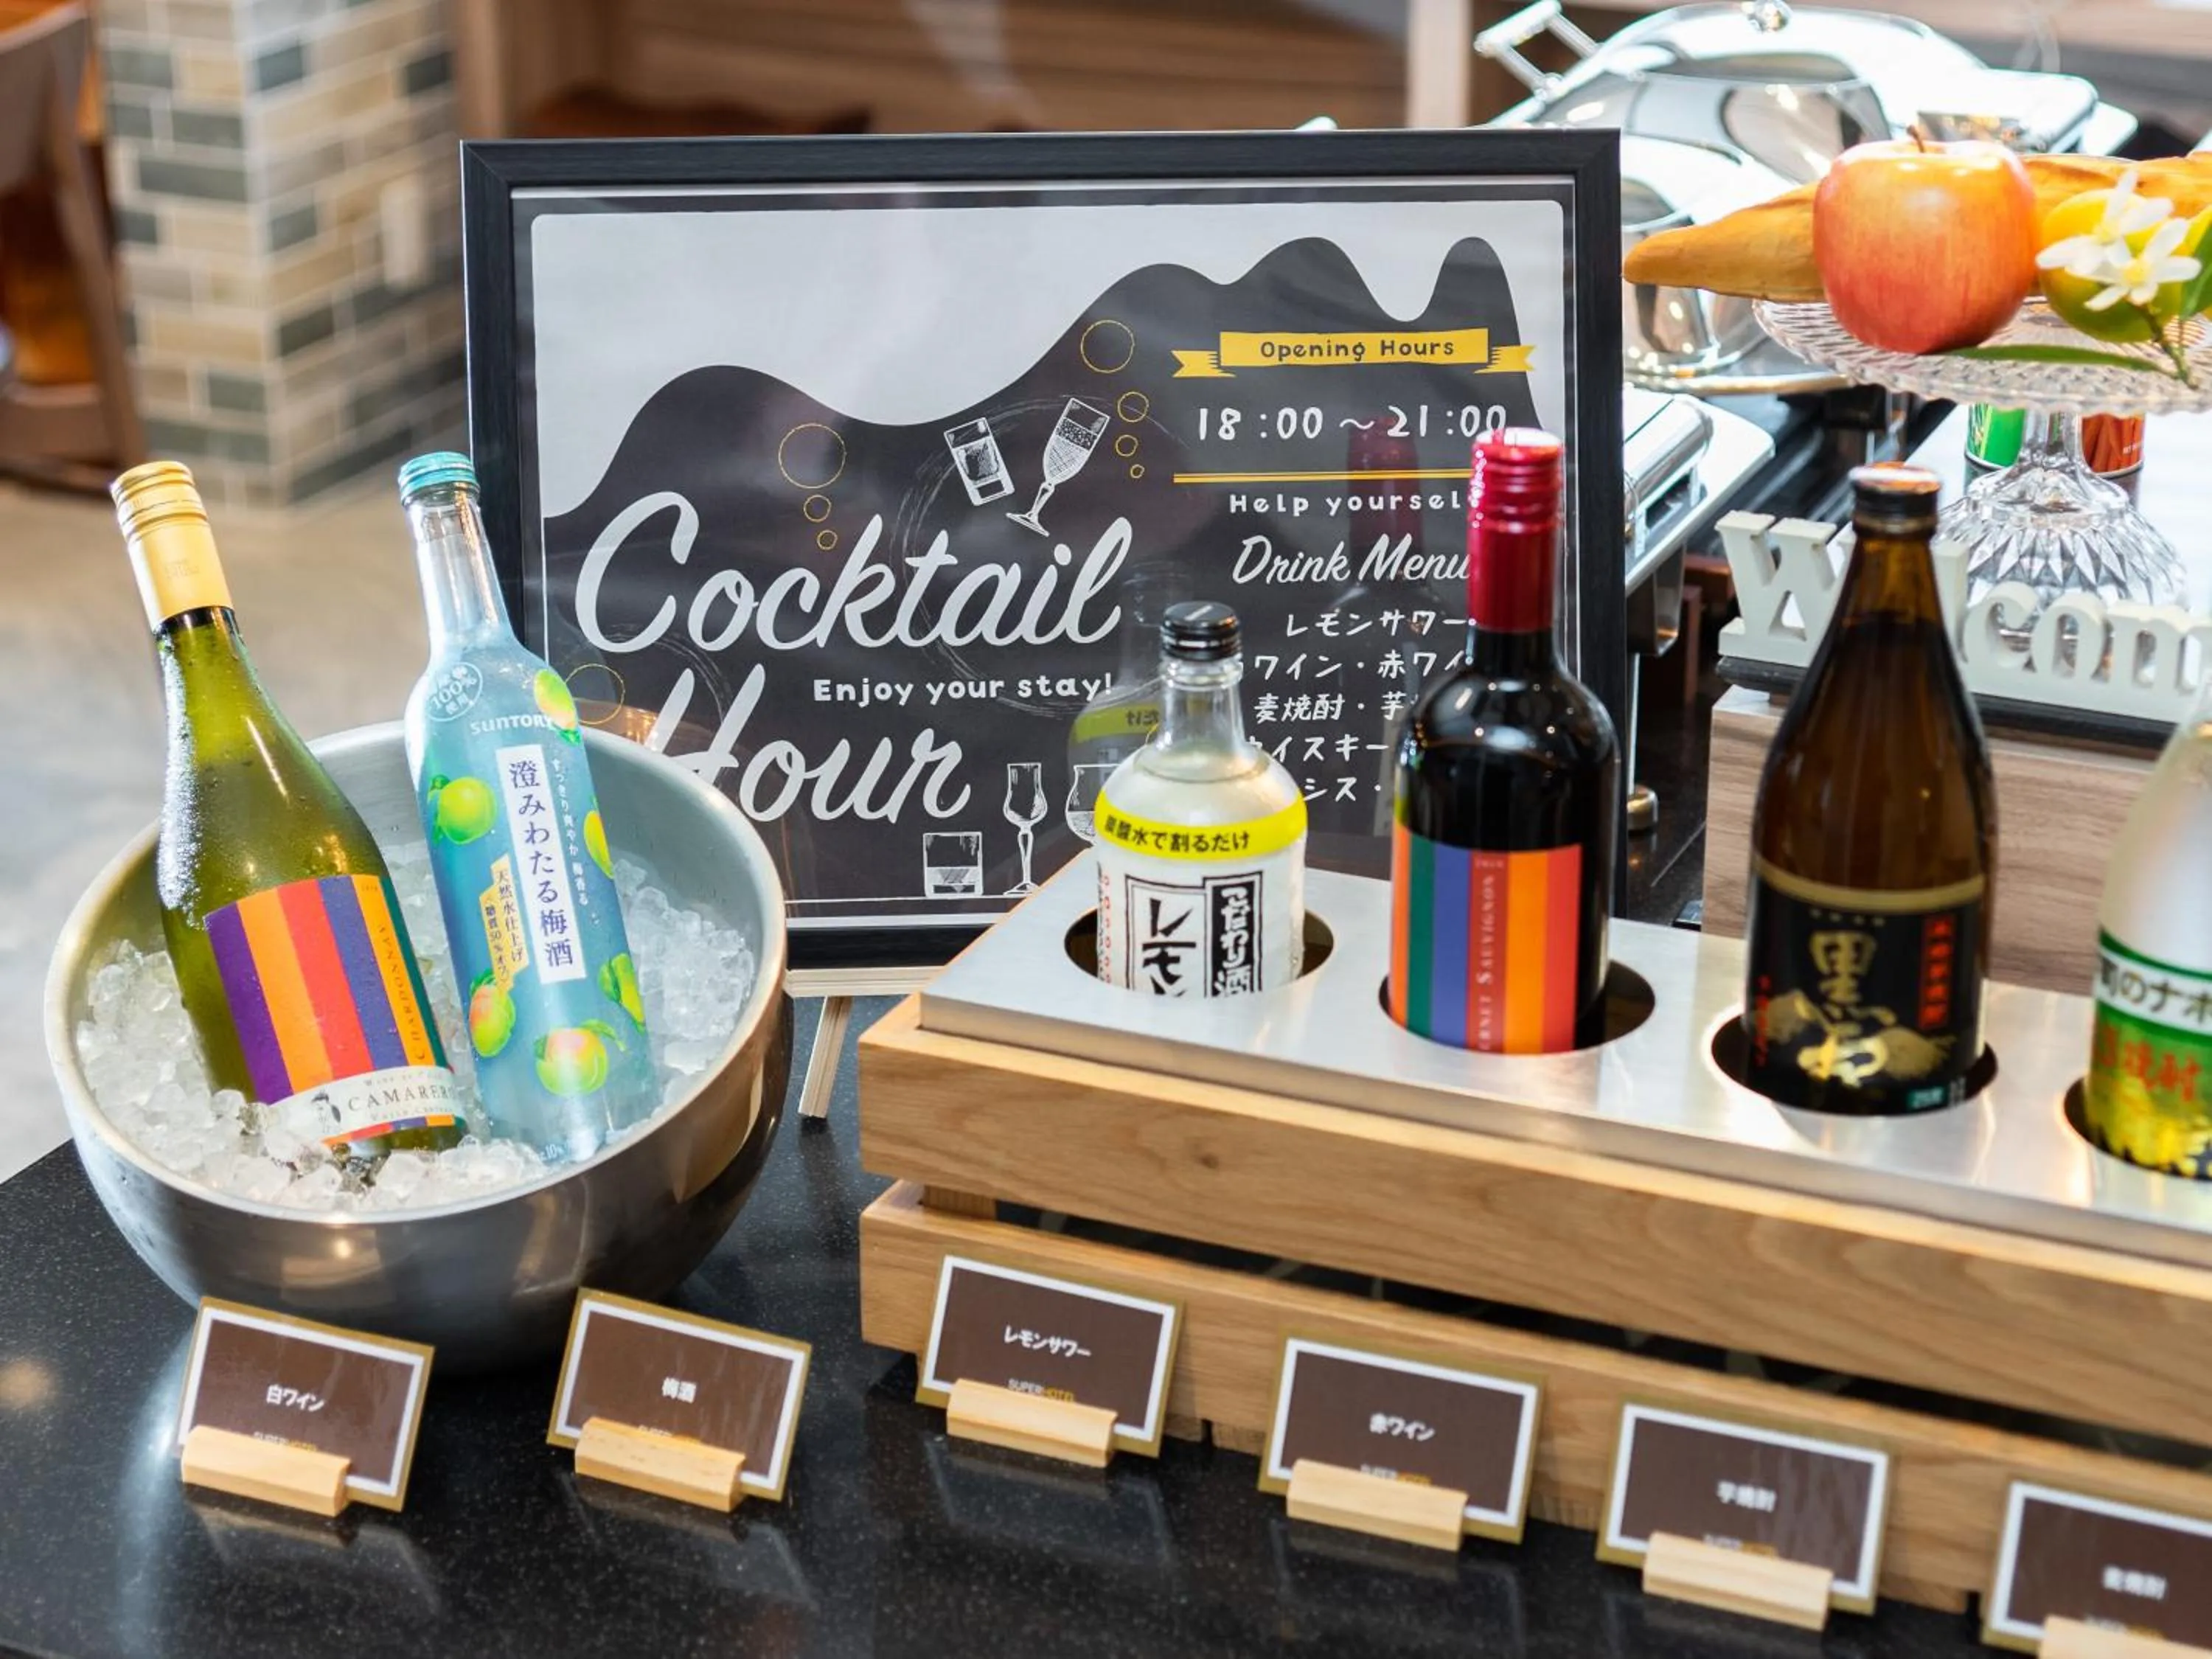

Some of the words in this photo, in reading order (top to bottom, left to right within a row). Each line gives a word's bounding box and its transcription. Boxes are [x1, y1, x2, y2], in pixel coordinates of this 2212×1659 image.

[1260, 340, 1366, 361] Opening
[1380, 338, 1455, 356] Hours
[1229, 494, 1310, 516] Help
[1326, 491, 1461, 516] yoursel
[575, 491, 1133, 654] Cocktail
[1232, 535, 1351, 585] Drink
[1358, 532, 1470, 583] Menu
[1715, 509, 2212, 697] Wcom
[1287, 610, 1469, 639] レモンサワー
[1254, 650, 1467, 681] ワイン・赤ワイ
[813, 678, 917, 708] Enjoy
[925, 678, 1006, 707] your
[1018, 672, 1113, 708] stay!
[1253, 691, 1419, 725] 麦焼酎・芋
[642, 663, 971, 824] Hour
[508, 760, 574, 967] 澄みわたる梅酒
[348, 1084, 456, 1112] CAMARER
[1004, 1324, 1092, 1357] レモンサワー
[266, 1383, 325, 1412] 白ワイン
